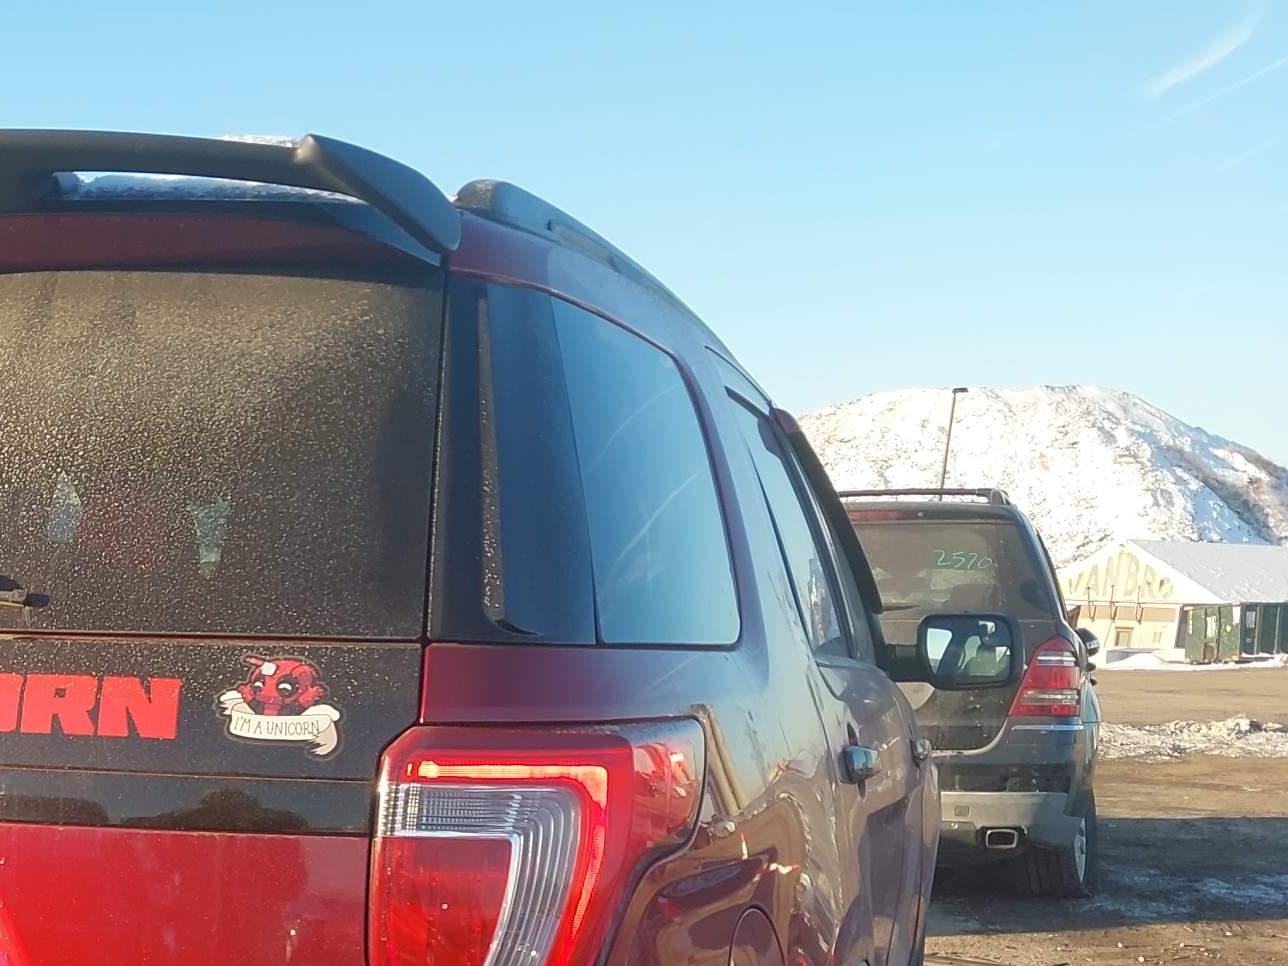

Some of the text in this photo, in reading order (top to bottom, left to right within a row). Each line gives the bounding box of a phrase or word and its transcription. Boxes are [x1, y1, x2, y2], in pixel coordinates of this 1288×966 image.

[234, 717, 320, 737] I'M A UNICORN
